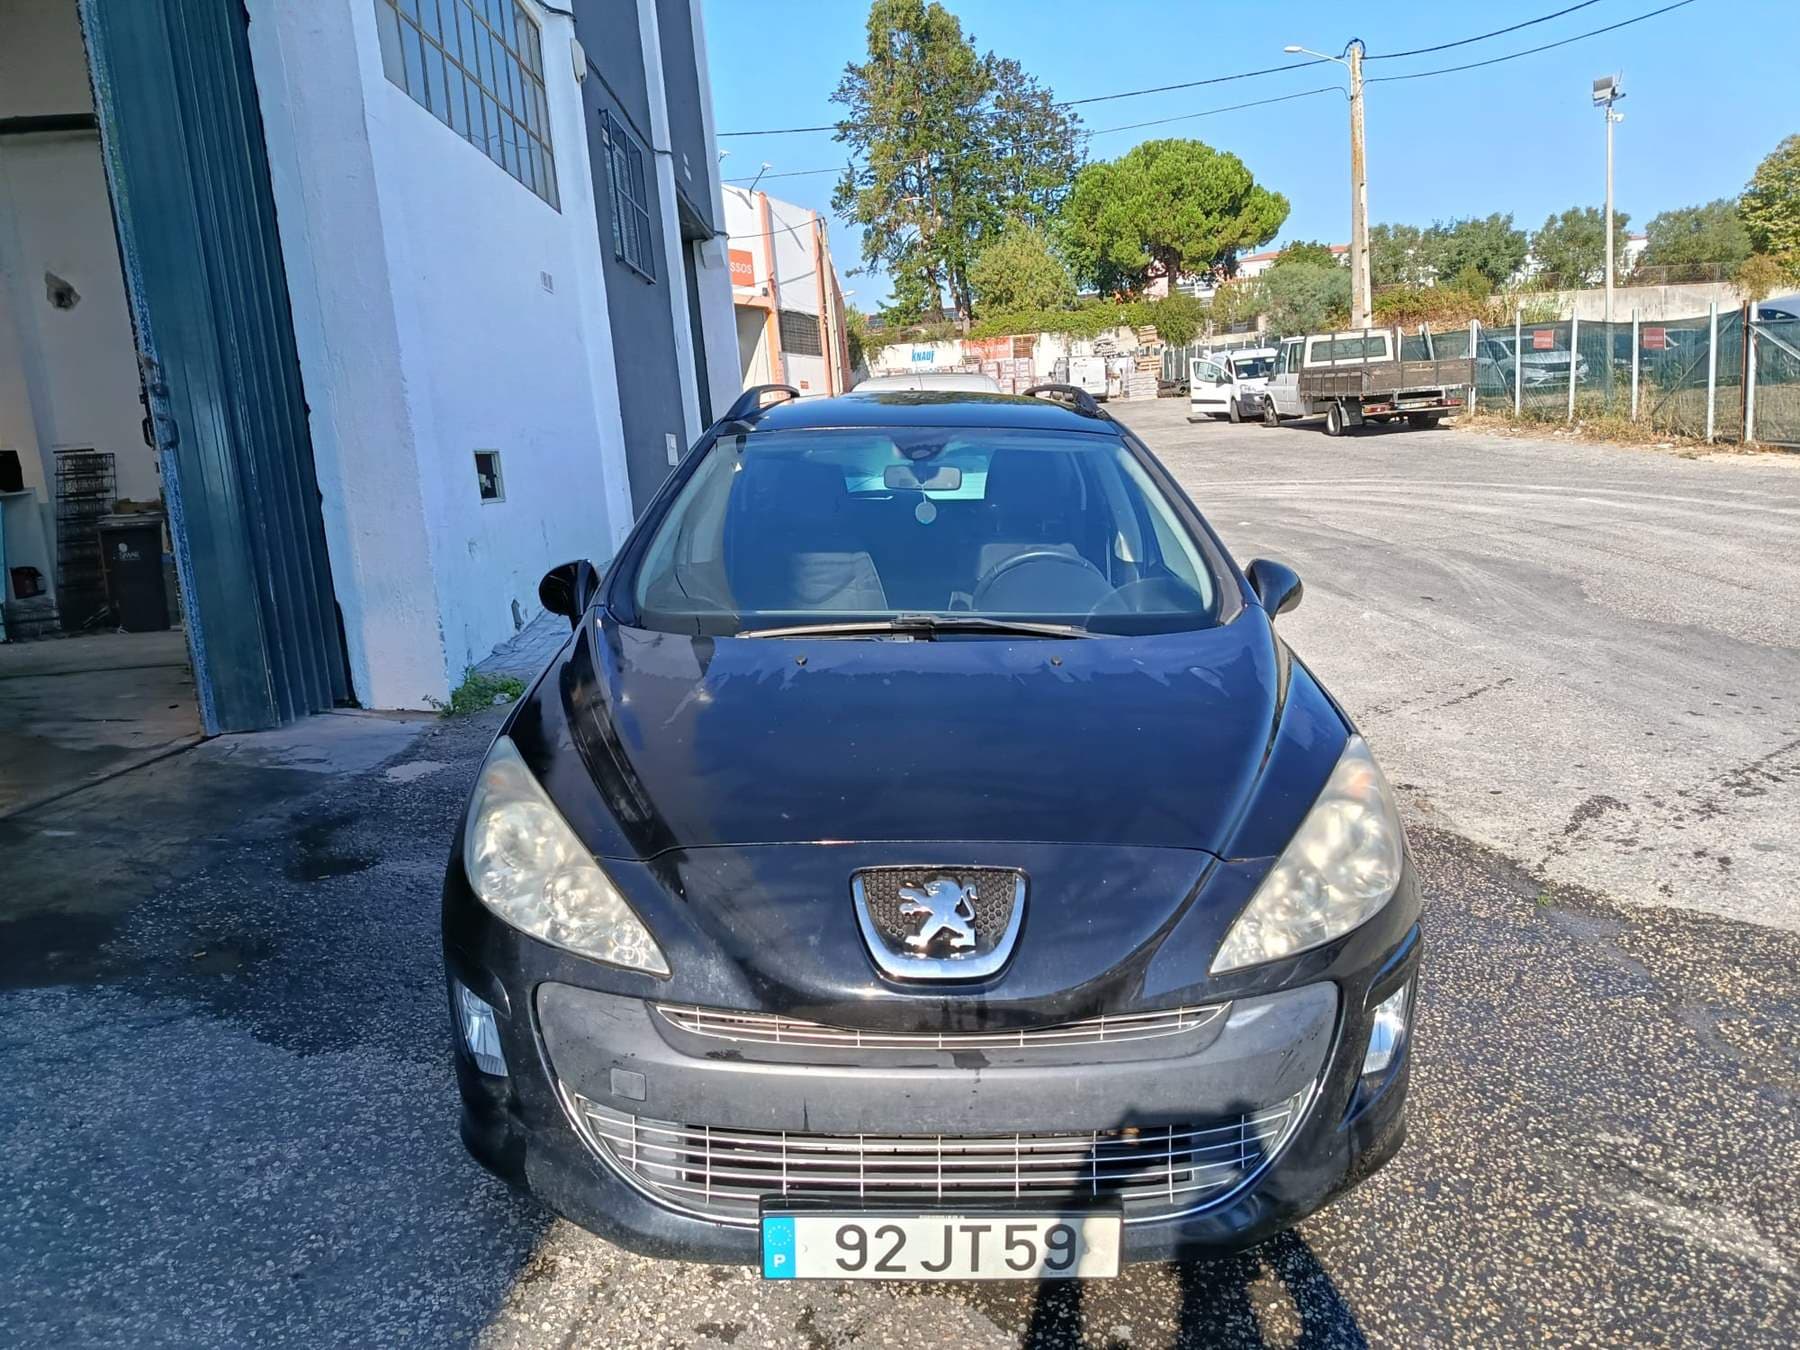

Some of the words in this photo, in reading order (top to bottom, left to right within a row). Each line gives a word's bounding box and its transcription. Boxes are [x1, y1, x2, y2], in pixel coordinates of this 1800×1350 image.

[773, 1255, 786, 1267] P
[835, 1224, 906, 1272] 92
[920, 1224, 991, 1272] JT
[1004, 1224, 1077, 1272] 59
